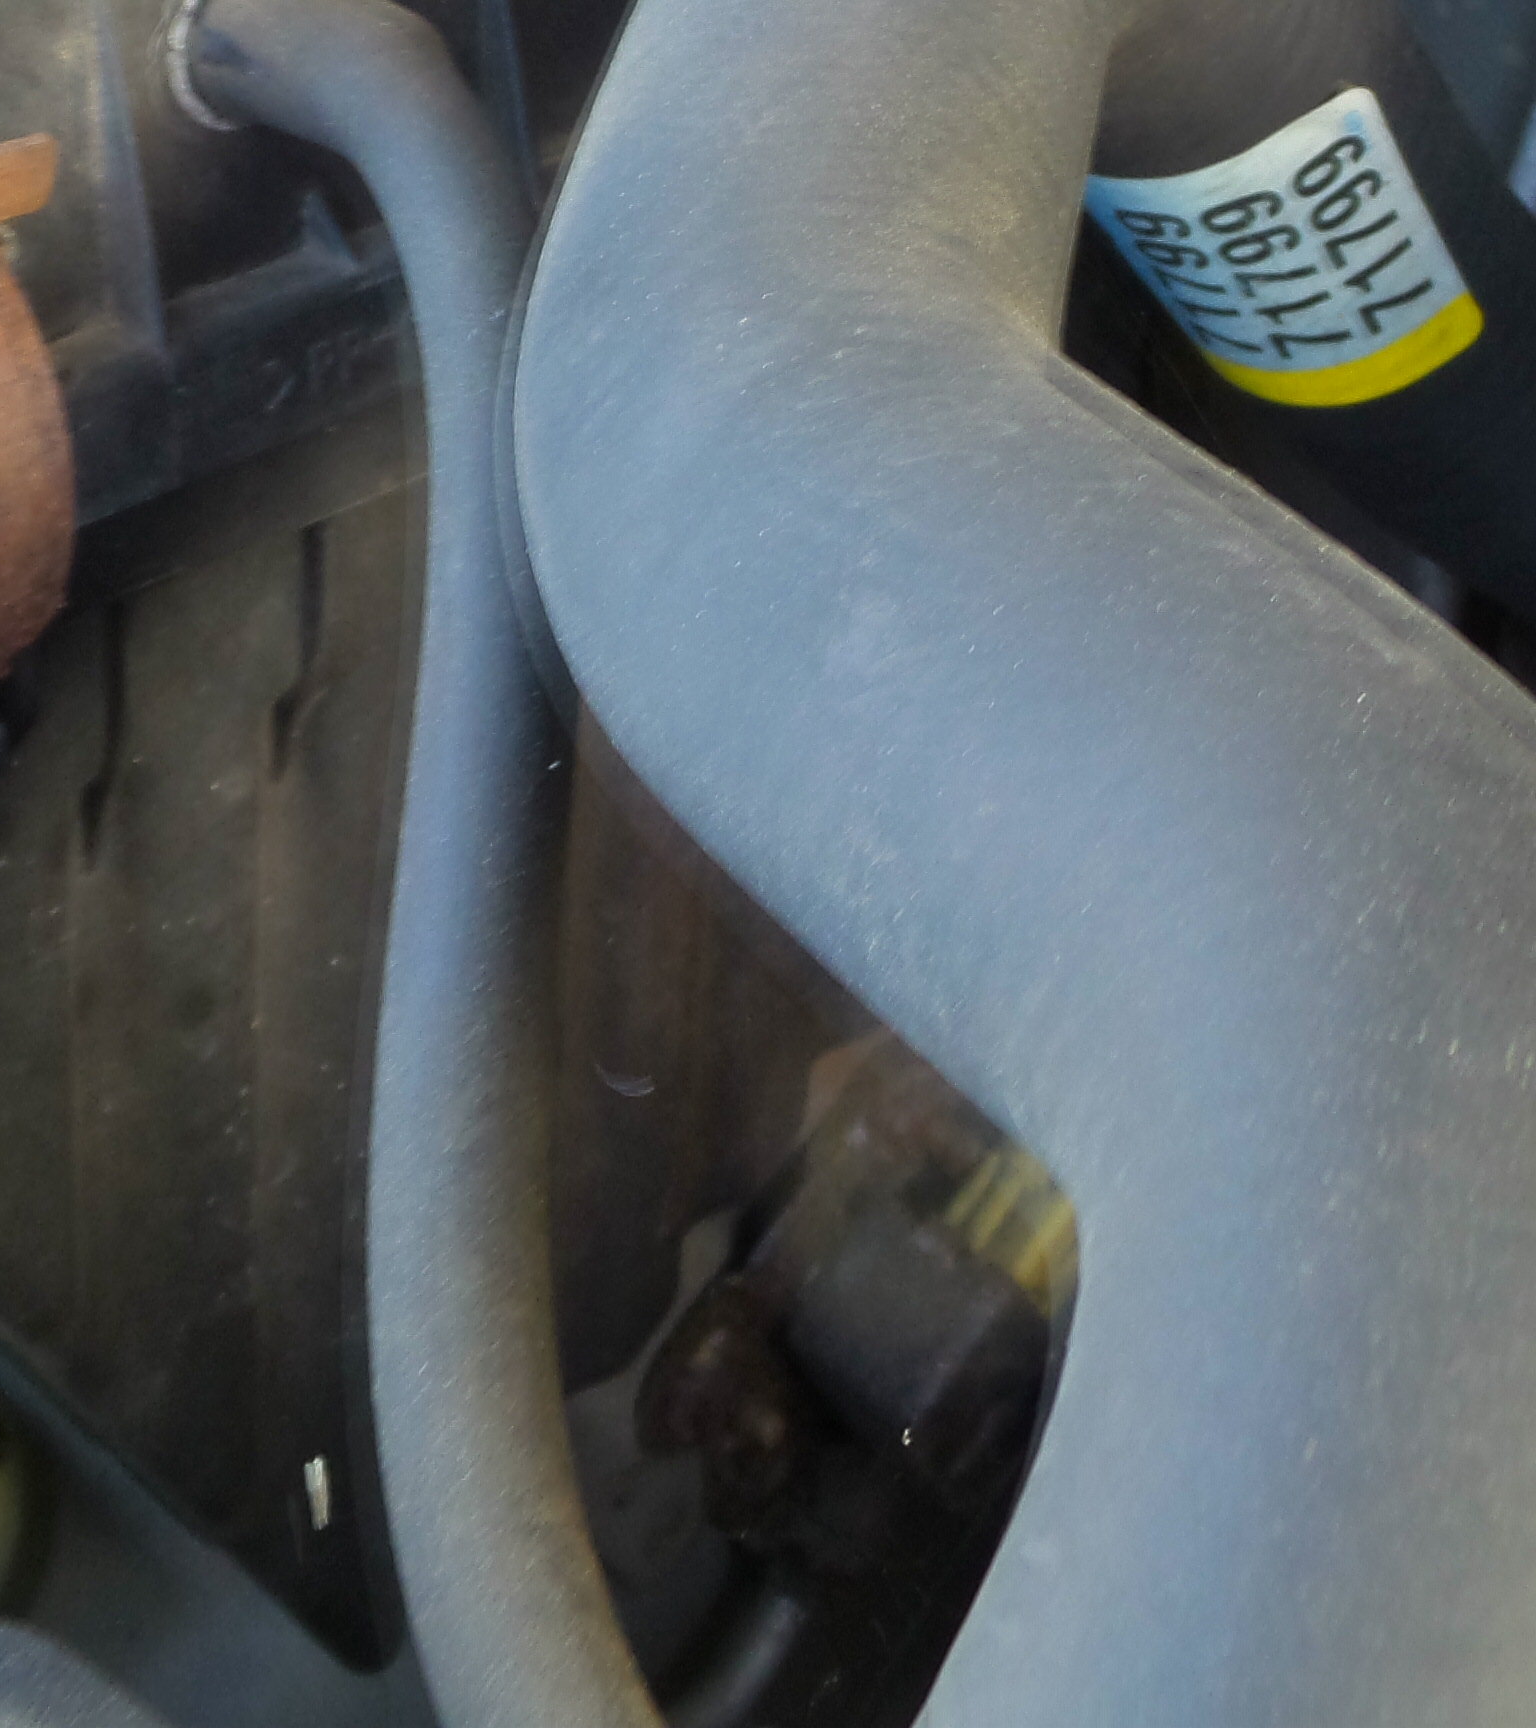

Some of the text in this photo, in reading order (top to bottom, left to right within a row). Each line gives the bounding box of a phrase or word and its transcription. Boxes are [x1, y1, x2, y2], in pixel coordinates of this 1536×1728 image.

[1115, 209, 1263, 354] 71799
[1199, 190, 1352, 360] 71799
[1291, 134, 1433, 335] 71799
